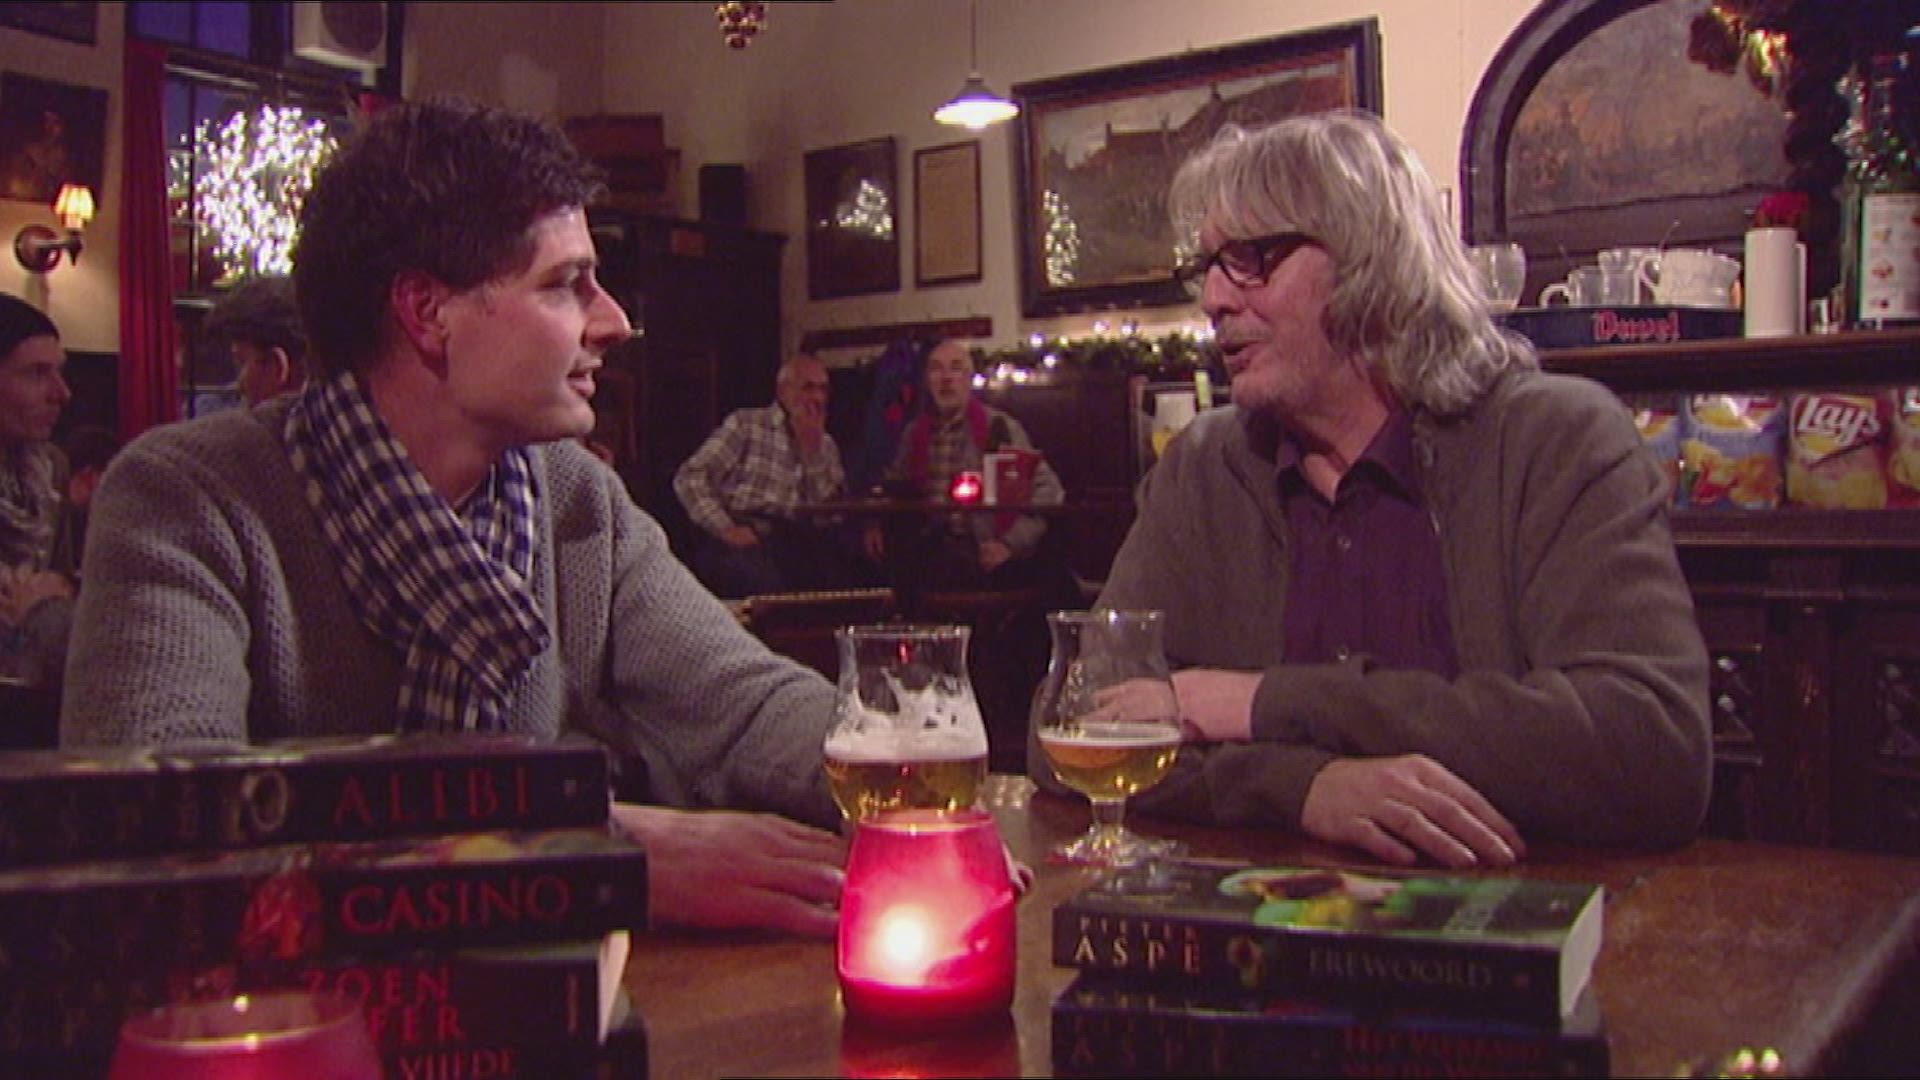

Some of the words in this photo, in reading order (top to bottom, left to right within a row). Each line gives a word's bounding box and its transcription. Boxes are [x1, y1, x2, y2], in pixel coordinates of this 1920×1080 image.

[1594, 309, 1680, 342] Duvel
[333, 765, 533, 830] ALIBI
[340, 875, 573, 935] CASINO
[1074, 934, 1200, 975] ASPE
[368, 1004, 468, 1042] FER
